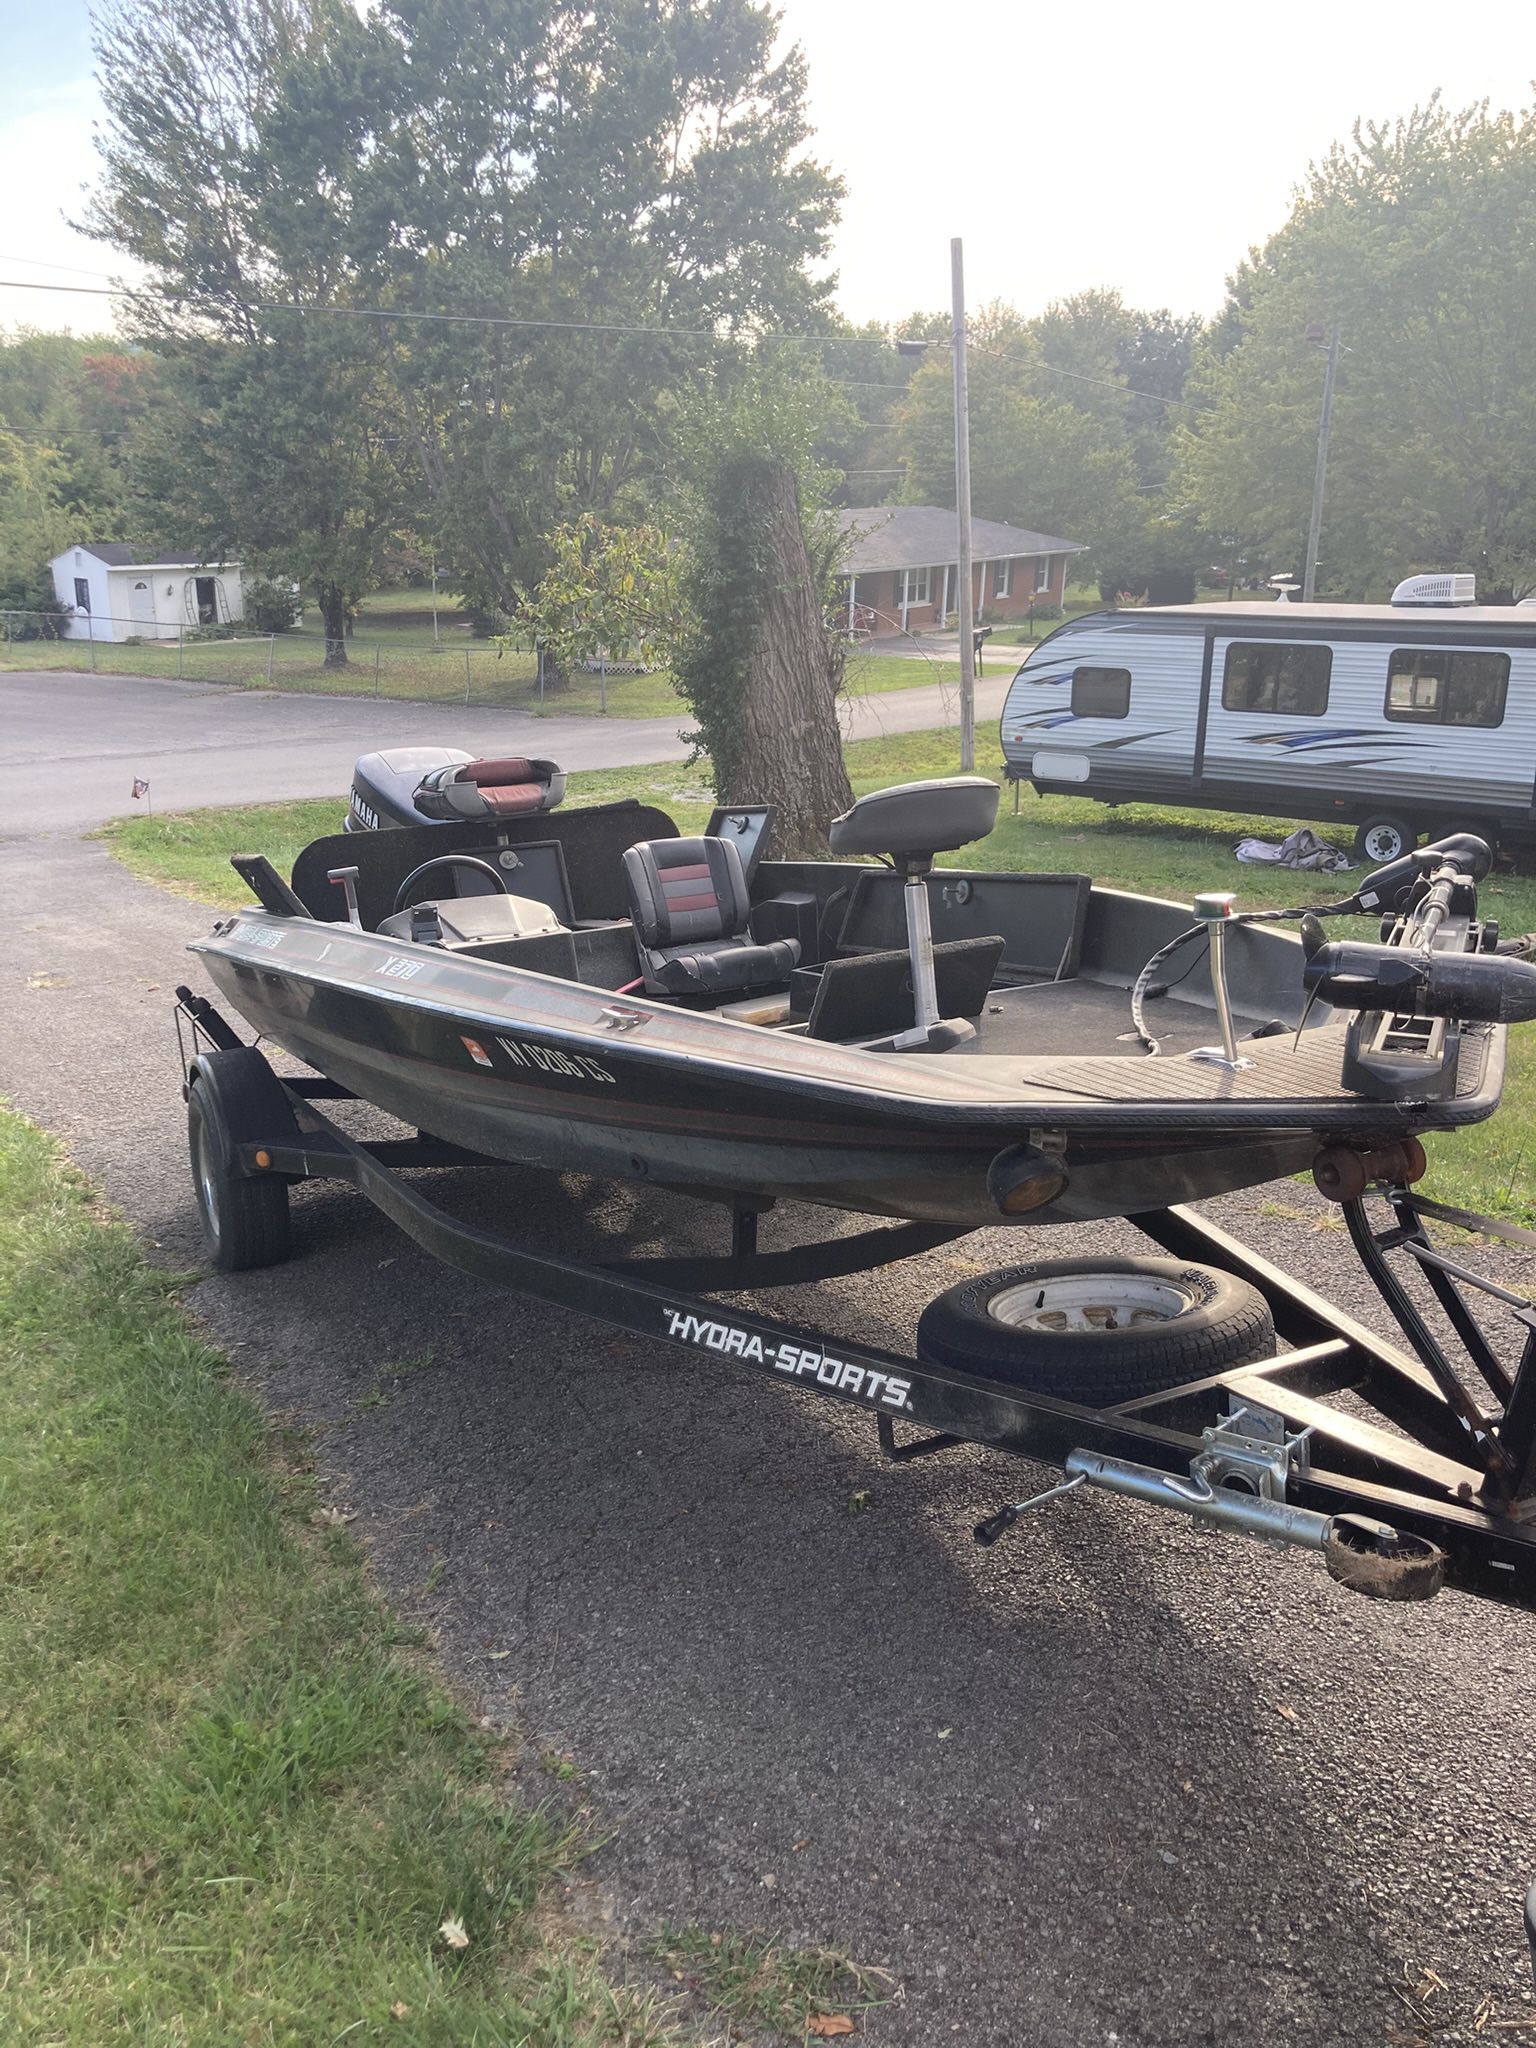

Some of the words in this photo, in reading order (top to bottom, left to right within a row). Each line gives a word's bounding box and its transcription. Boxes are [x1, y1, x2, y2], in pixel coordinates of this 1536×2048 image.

[350, 787, 380, 830] AMAHA
[495, 1036, 532, 1068] KY
[521, 1043, 585, 1078] 0206
[573, 1054, 617, 1084] CS
[668, 1312, 912, 1407] HYDRA-SPORTS
